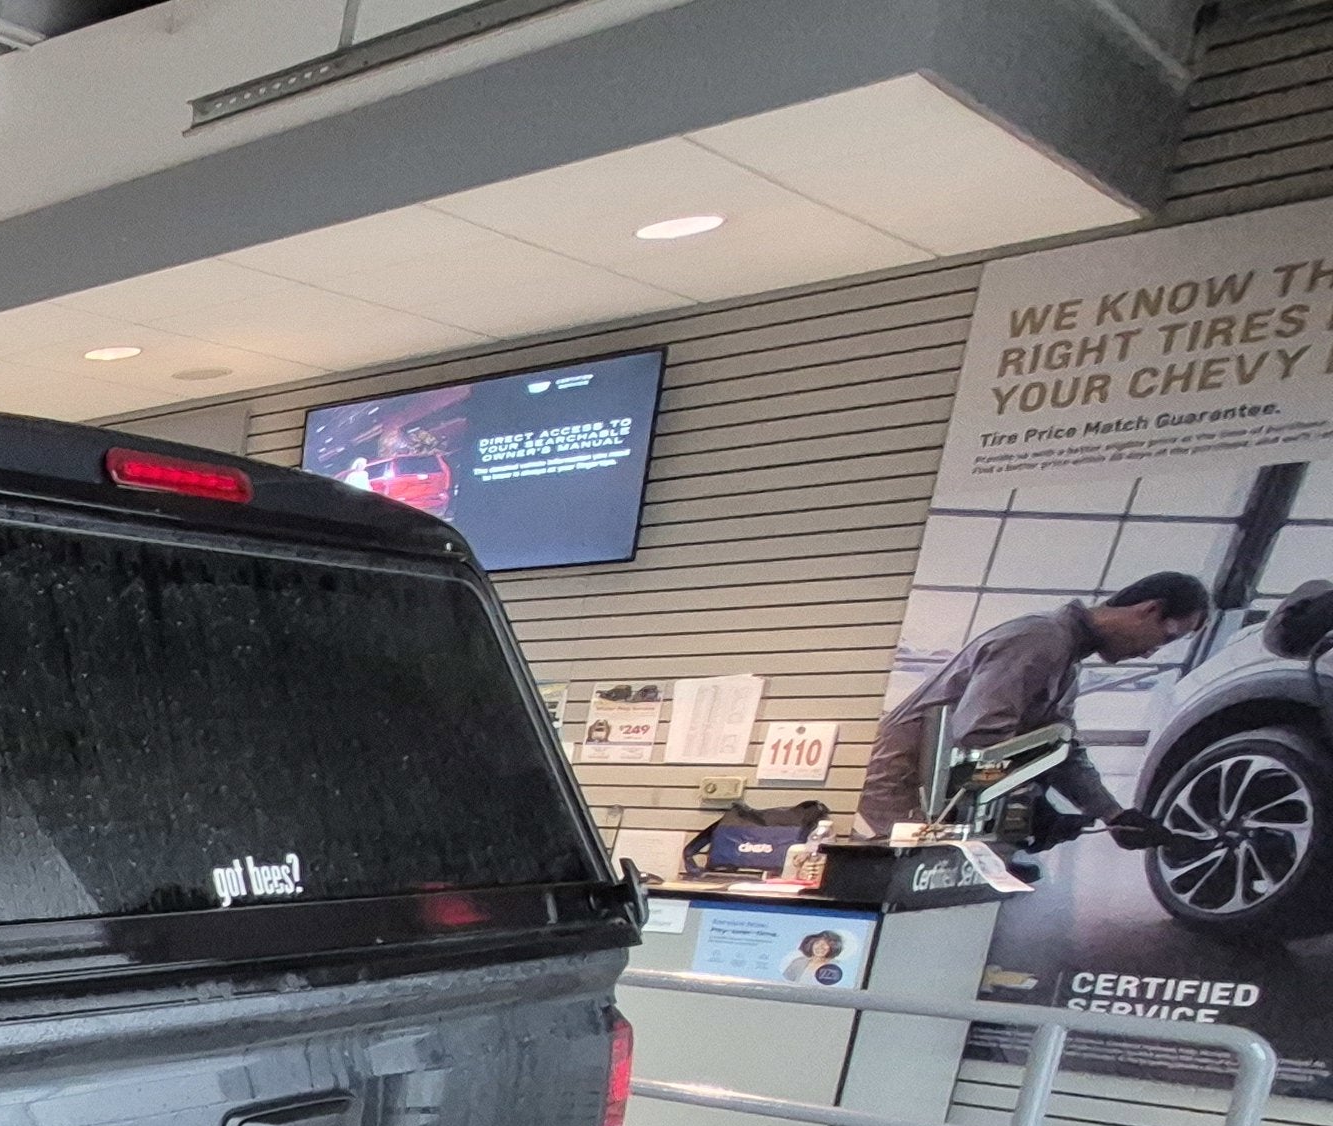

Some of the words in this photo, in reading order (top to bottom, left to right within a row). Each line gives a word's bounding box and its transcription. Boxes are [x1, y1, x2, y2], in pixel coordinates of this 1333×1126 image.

[1009, 299, 1083, 338] WE
[1096, 270, 1254, 326] KNOW
[996, 328, 1142, 378] RIGHT
[1158, 304, 1310, 355] TIRES
[991, 373, 1111, 415] YOUR
[1128, 344, 1313, 399] CHEVY
[479, 432, 534, 448] DIRECT
[539, 422, 604, 438] ACCESS
[609, 418, 632, 428] TO
[479, 443, 519, 455] YOUR
[524, 427, 631, 448] SEARCHABLE
[981, 432, 1018, 448] Tire
[1024, 427, 1076, 443] Price
[1083, 416, 1148, 436] Match
[1155, 401, 1281, 429] Guarantee.
[482, 446, 551, 462] OWNER'S
[557, 438, 624, 452] MANUAL
[770, 739, 822, 766] 1110
[212, 858, 248, 908] got
[245, 853, 304, 895] bees?
[1071, 972, 1260, 1008] CERTIFIED
